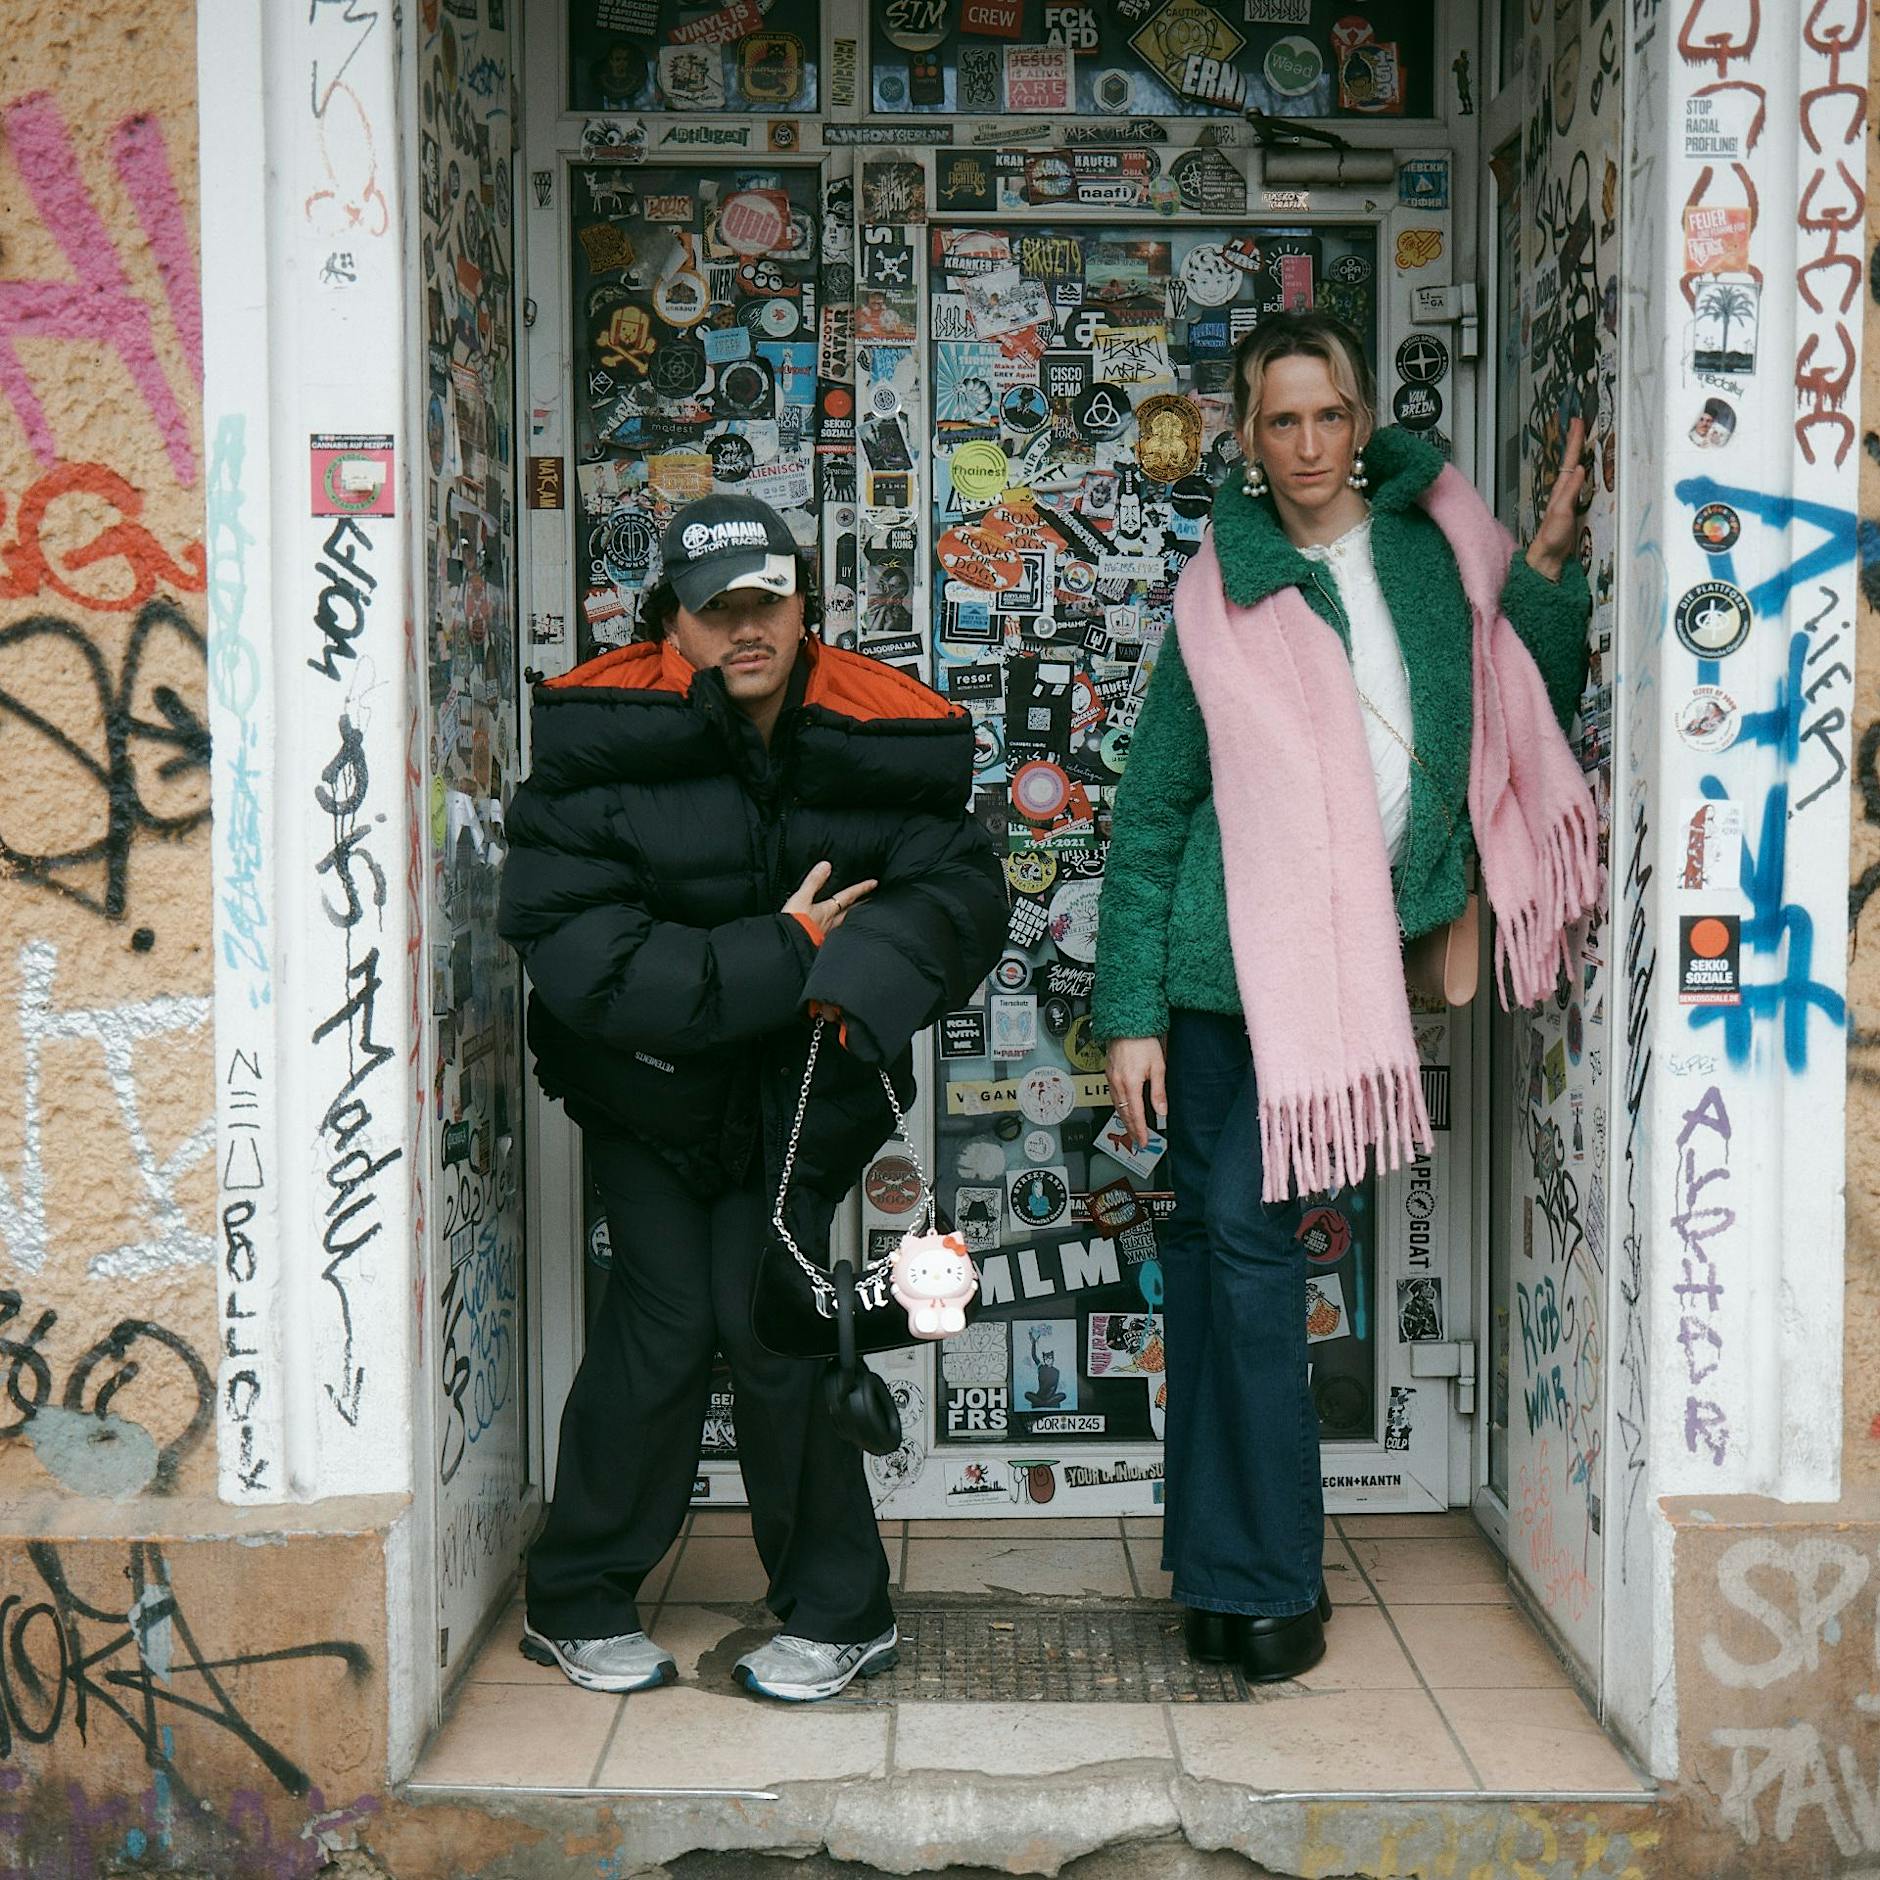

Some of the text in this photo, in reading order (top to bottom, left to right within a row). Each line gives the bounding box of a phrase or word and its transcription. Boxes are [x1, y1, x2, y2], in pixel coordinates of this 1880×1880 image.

[968, 6, 1015, 28] CREW
[1045, 7, 1097, 28] FCK
[1166, 8, 1208, 17] CAUTION
[673, 12, 729, 43] VINYL
[730, 4, 749, 23] IS
[1047, 28, 1099, 49] AFD
[1012, 80, 1065, 95] ARE
[1011, 94, 1043, 108] YOU
[1686, 100, 1713, 115] STOP
[1685, 119, 1720, 133] RACIAL
[1685, 137, 1739, 152] PROFILING!
[995, 154, 1118, 168] KRAN HAUFEN
[1079, 186, 1129, 199] naafi
[944, 256, 993, 271] KRANKER
[1050, 366, 1082, 382] CISCO
[1050, 382, 1082, 398] PEMA
[1408, 389, 1427, 401] VAN
[1401, 400, 1436, 416] BREDA
[651, 421, 694, 434] modest
[823, 419, 852, 429] SEKKO
[820, 429, 855, 438] SOZIALE
[708, 521, 768, 539] YAMAHA
[891, 529, 912, 539] KING
[687, 536, 769, 560] FACTORY RACING
[891, 539, 914, 550] KONG
[1696, 582, 1748, 612] PLATTFORM
[955, 672, 993, 684] resør
[1095, 679, 1131, 695] HAUFE
[1689, 959, 1729, 972] SEKKO
[1047, 963, 1096, 984] SUMMER
[1685, 971, 1734, 985] SOZIALE
[1047, 978, 1093, 998] ROYALE
[946, 1019, 978, 1029] ROLL
[946, 1029, 980, 1038] WITH
[956, 1083, 1111, 1104] VGAN LIF
[1012, 1170, 1046, 1194] STREET
[1409, 1220, 1431, 1269] GOAT
[949, 1388, 1008, 1409] JOH
[949, 1409, 1008, 1430] FRS
[1078, 1416, 1101, 1430] 245
[1068, 1465, 1098, 1487] YOUR
